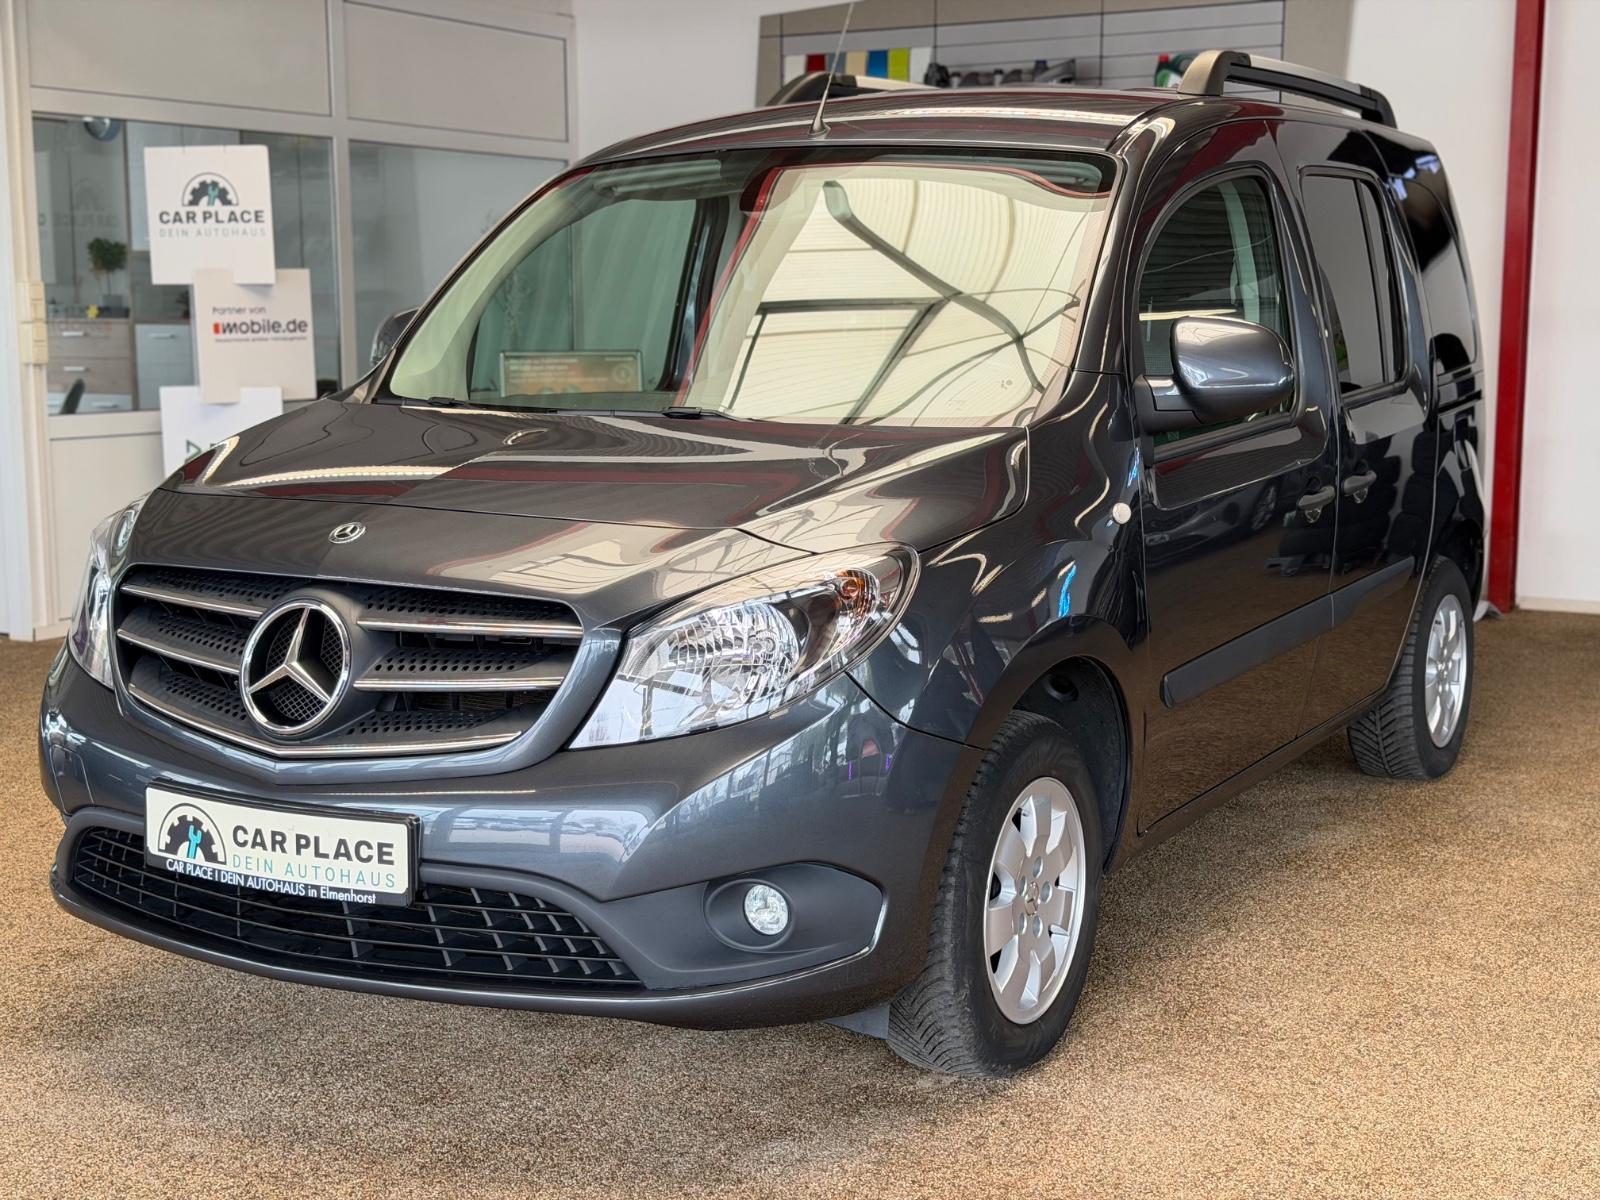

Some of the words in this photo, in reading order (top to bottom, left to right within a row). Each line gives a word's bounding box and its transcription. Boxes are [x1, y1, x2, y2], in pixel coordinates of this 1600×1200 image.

[159, 210, 197, 224] CAR
[202, 210, 265, 223] PLACE
[159, 227, 189, 237] DEIN
[196, 226, 266, 237] AUTOHAUS
[212, 306, 247, 315] Partner
[221, 318, 308, 335] mobile.de
[232, 825, 287, 854] CAR
[295, 834, 395, 866] PLACE
[233, 854, 273, 874] DEIN
[285, 862, 396, 888] AUTOHAUS
[166, 859, 185, 874] CAR
[186, 864, 213, 880] PLACE
[221, 870, 244, 886] DEIN
[246, 875, 305, 896] AUTOHAUS
[307, 885, 317, 897] in
[320, 886, 376, 904] Elmenhorst
